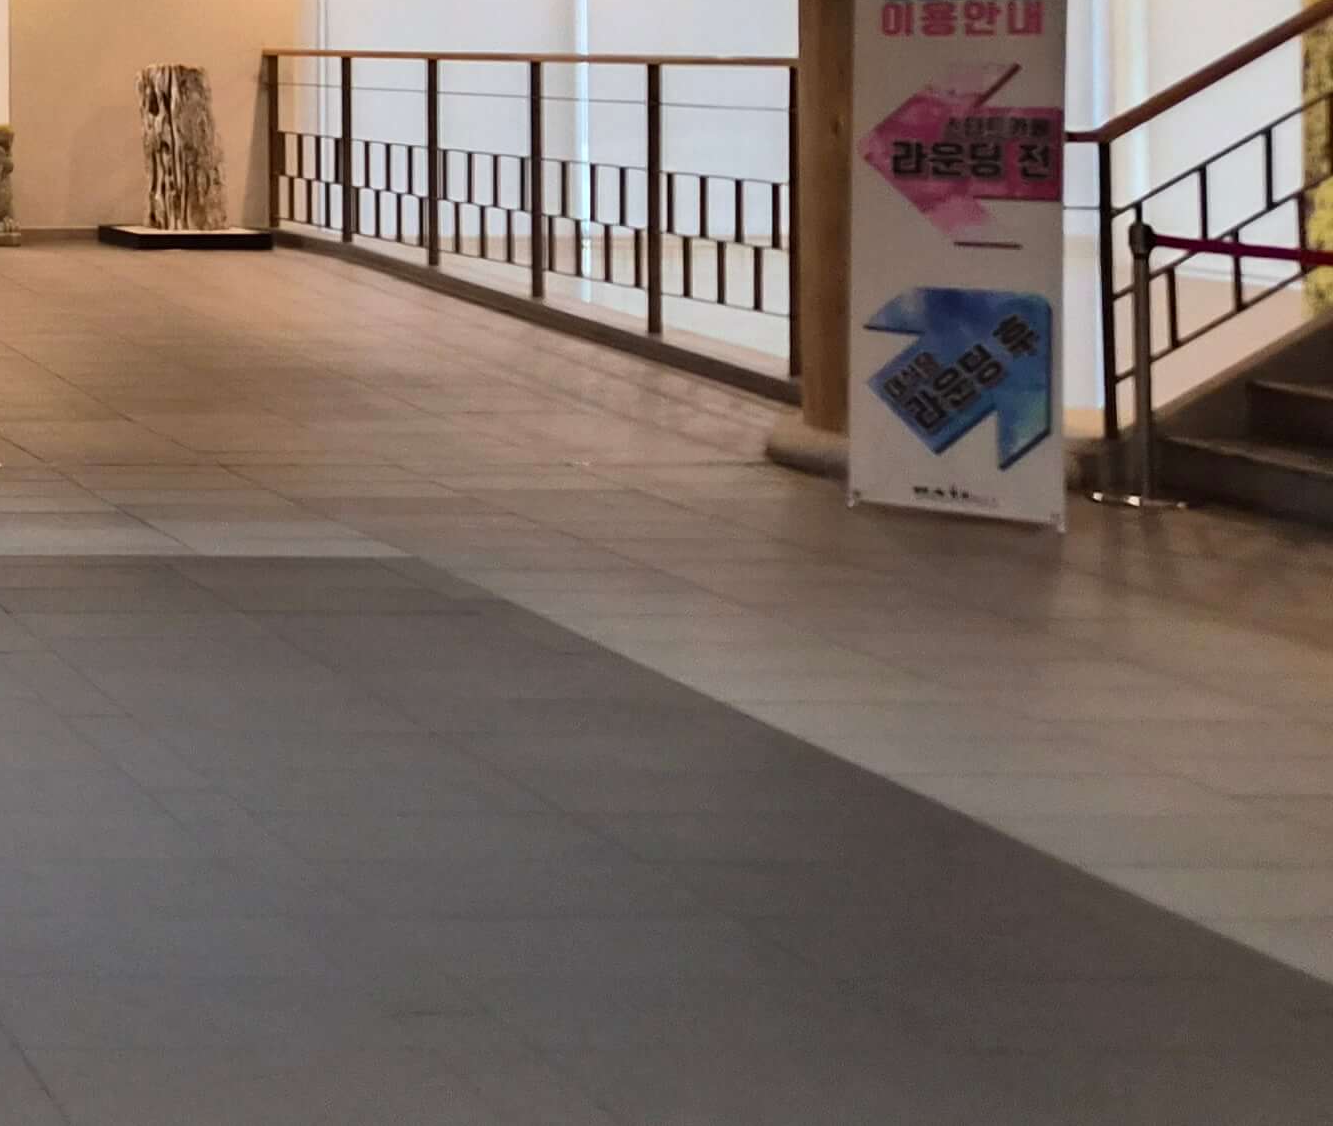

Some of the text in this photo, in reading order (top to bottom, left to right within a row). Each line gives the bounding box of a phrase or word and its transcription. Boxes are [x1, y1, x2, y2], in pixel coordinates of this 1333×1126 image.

[892, 139, 1050, 178] 라운딩 전
[902, 343, 1003, 430] 라운딩
